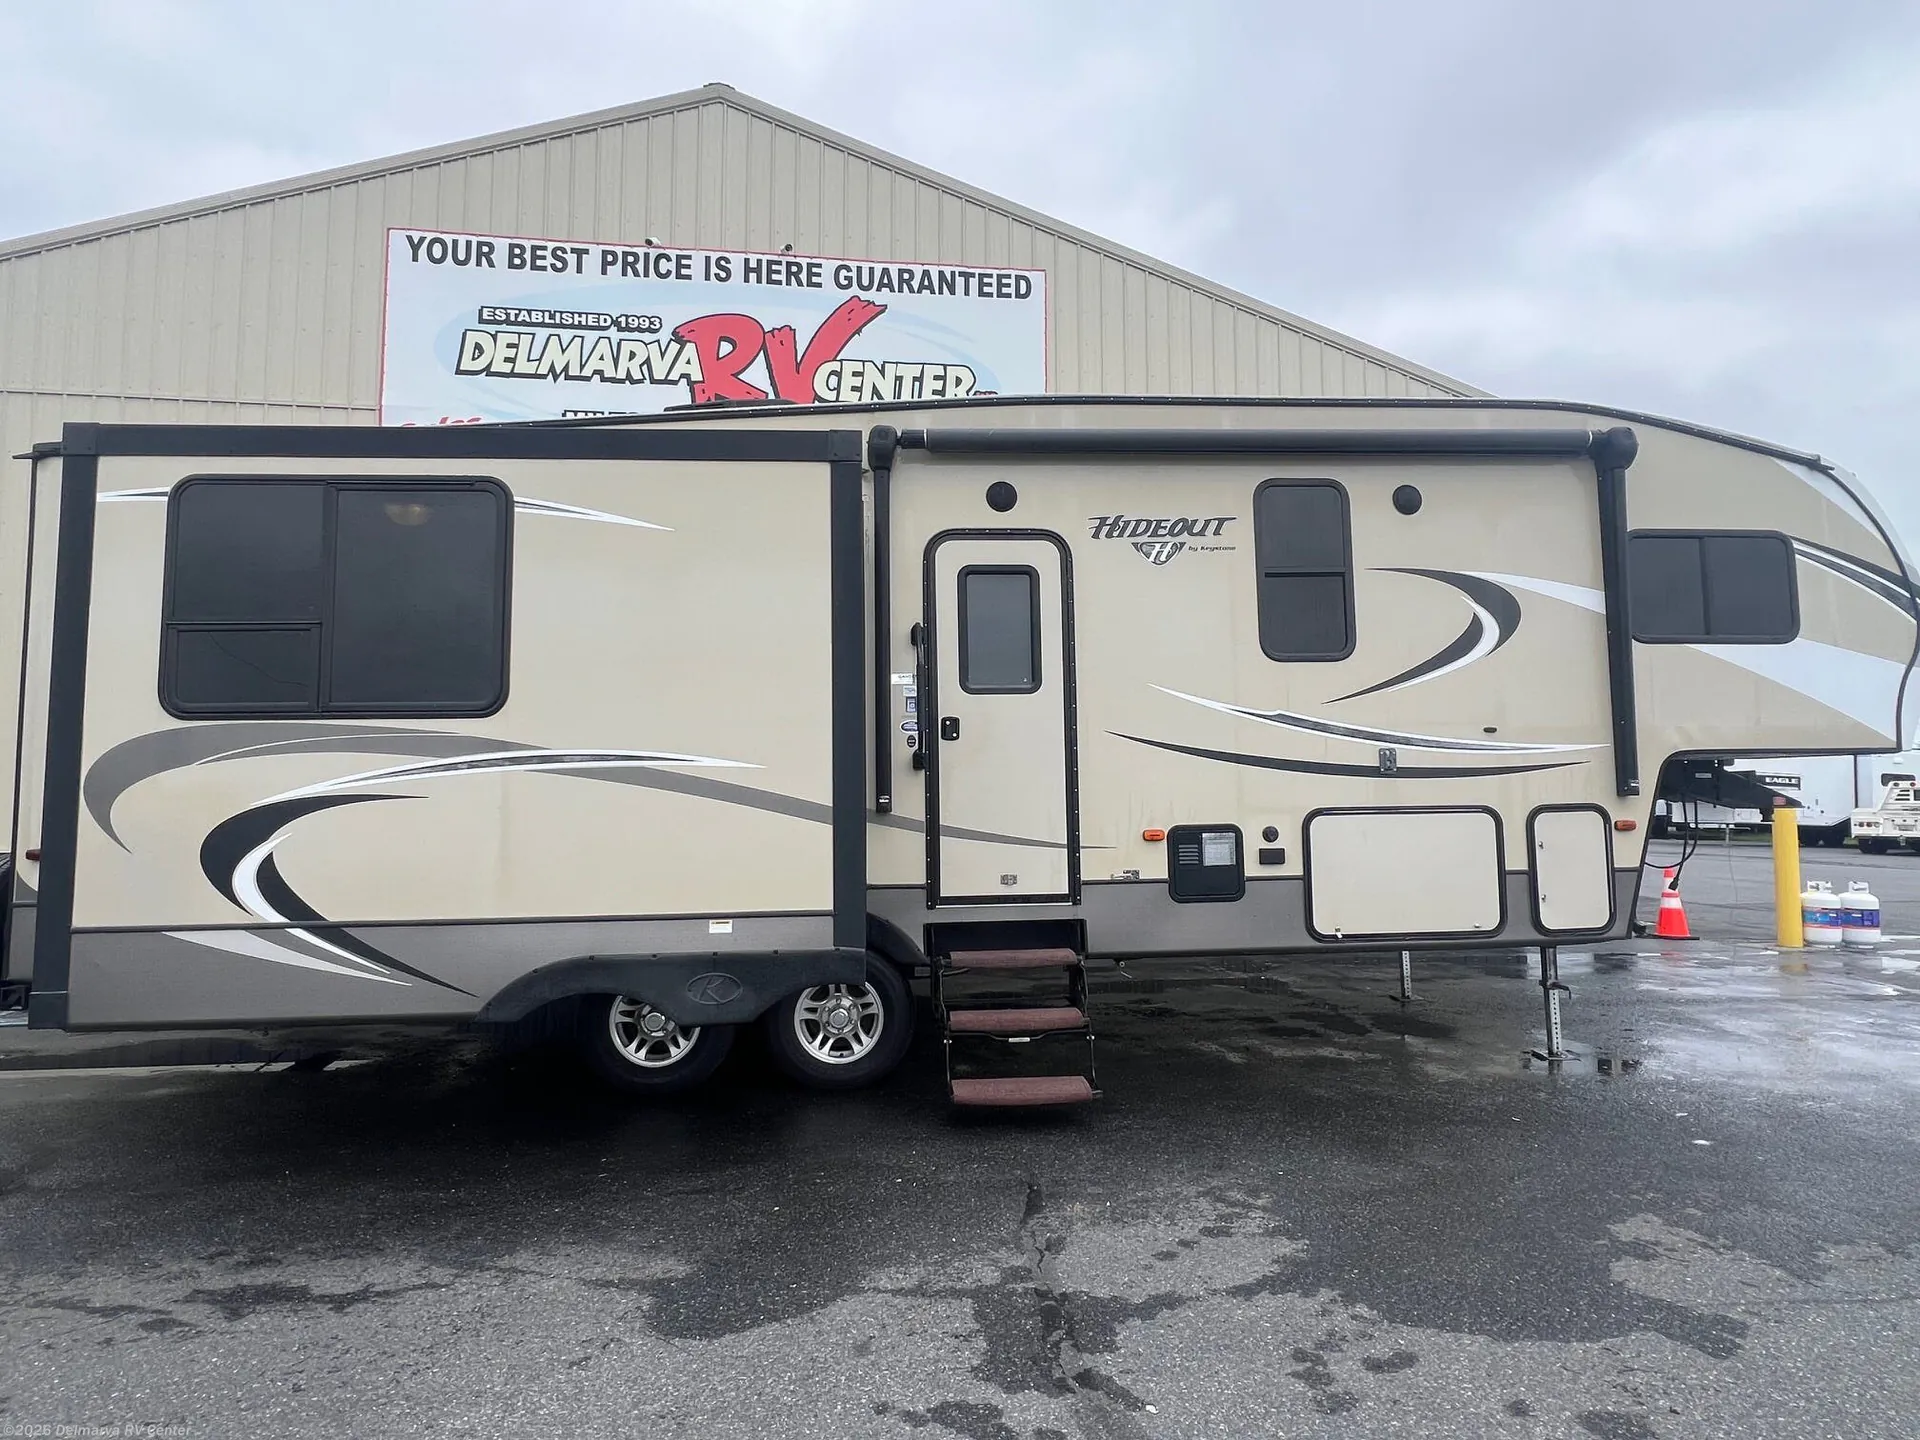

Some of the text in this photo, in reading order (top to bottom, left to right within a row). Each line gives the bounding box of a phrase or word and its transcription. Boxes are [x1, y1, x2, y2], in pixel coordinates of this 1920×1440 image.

[405, 234, 1033, 300] YOUR BEST PRICE IS HERE GUARANTEED
[478, 306, 663, 332] ESTABLISHED 1993
[455, 295, 976, 404] DELMARVA RV CENTER
[1087, 515, 1238, 540] HIDEOUT
[1765, 776, 1799, 785] EAGLE
